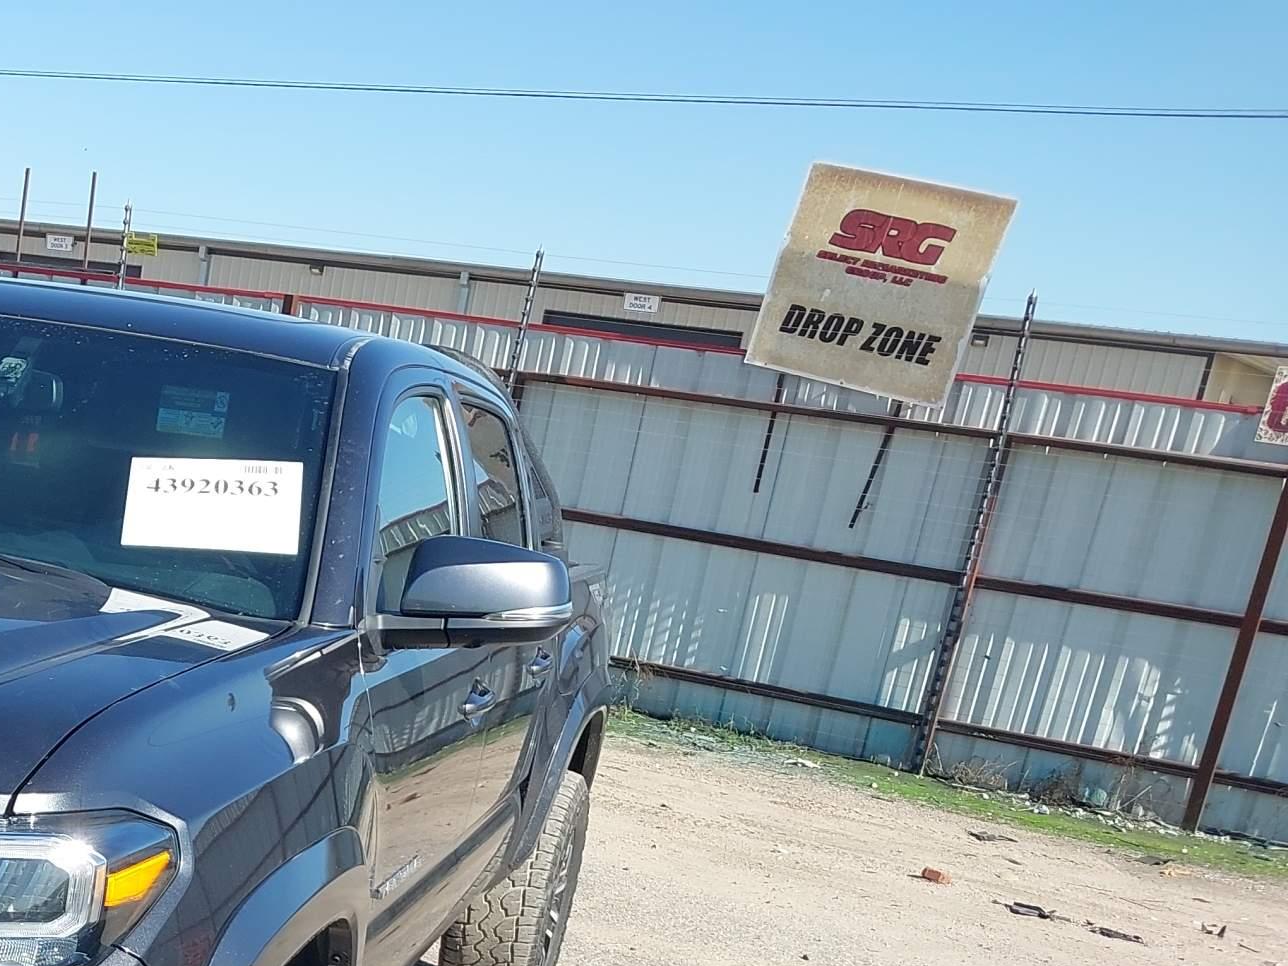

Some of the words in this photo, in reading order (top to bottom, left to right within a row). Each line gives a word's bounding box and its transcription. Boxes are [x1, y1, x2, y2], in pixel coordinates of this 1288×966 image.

[828, 209, 958, 266] SRG
[629, 302, 646, 310] DOOR
[778, 303, 864, 347] DROP
[859, 322, 942, 366] ZONE
[146, 477, 280, 497] 43920363
